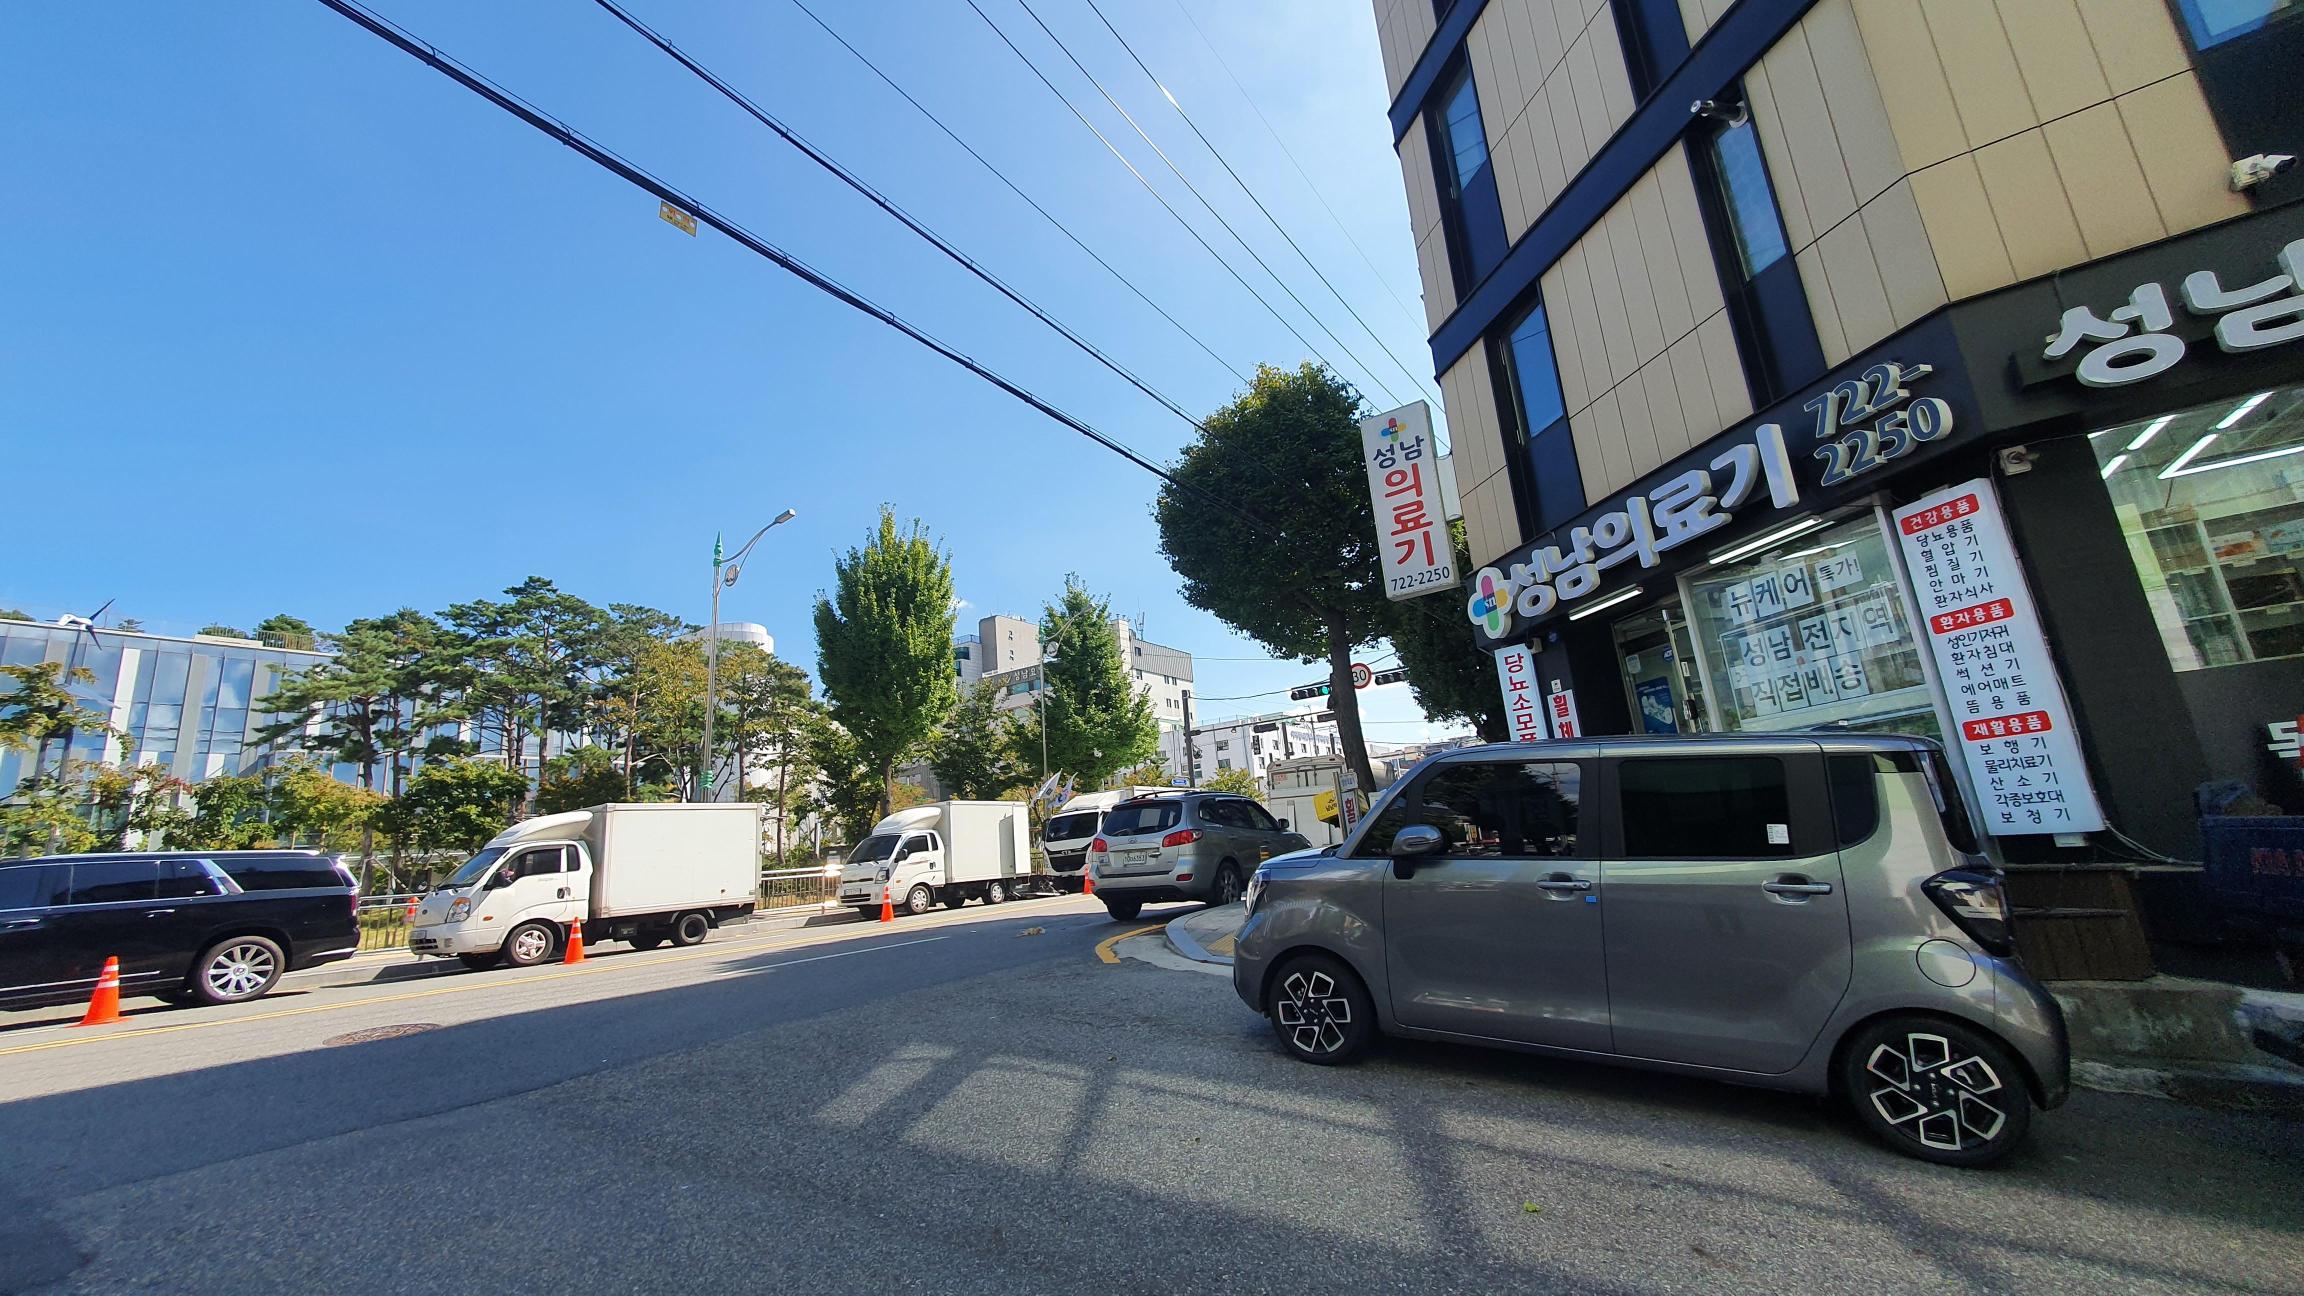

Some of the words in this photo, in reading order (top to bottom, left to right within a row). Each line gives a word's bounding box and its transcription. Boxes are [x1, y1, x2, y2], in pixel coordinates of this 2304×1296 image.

[2043, 238, 2304, 388] 성남
[1373, 435, 1424, 469] 성남
[1813, 397, 1953, 487] 2250
[1385, 463, 1434, 567] 의료기
[1910, 499, 1970, 530] 건강용품
[1916, 519, 1974, 547] 당뇨용품
[1391, 566, 1450, 591] 722-2250
[1731, 568, 1809, 616] 뉴케어
[1819, 558, 1860, 582] 특가!
[1934, 582, 1994, 608] 환자식사
[1940, 603, 2004, 629] 환자용품
[1743, 630, 1793, 666] 성남
[1802, 606, 1893, 651] 전지역
[1948, 625, 2010, 649] 성인기저귀
[1951, 641, 2015, 665] 환자침대
[1353, 669, 1367, 683] 30
[1752, 658, 1862, 706] 직접배송
[1961, 674, 2027, 695] 에어매트
[1972, 715, 2042, 736] 재활용품
[1985, 754, 2053, 774] 물리치료기
[1994, 790, 2065, 807] 각종보호대
